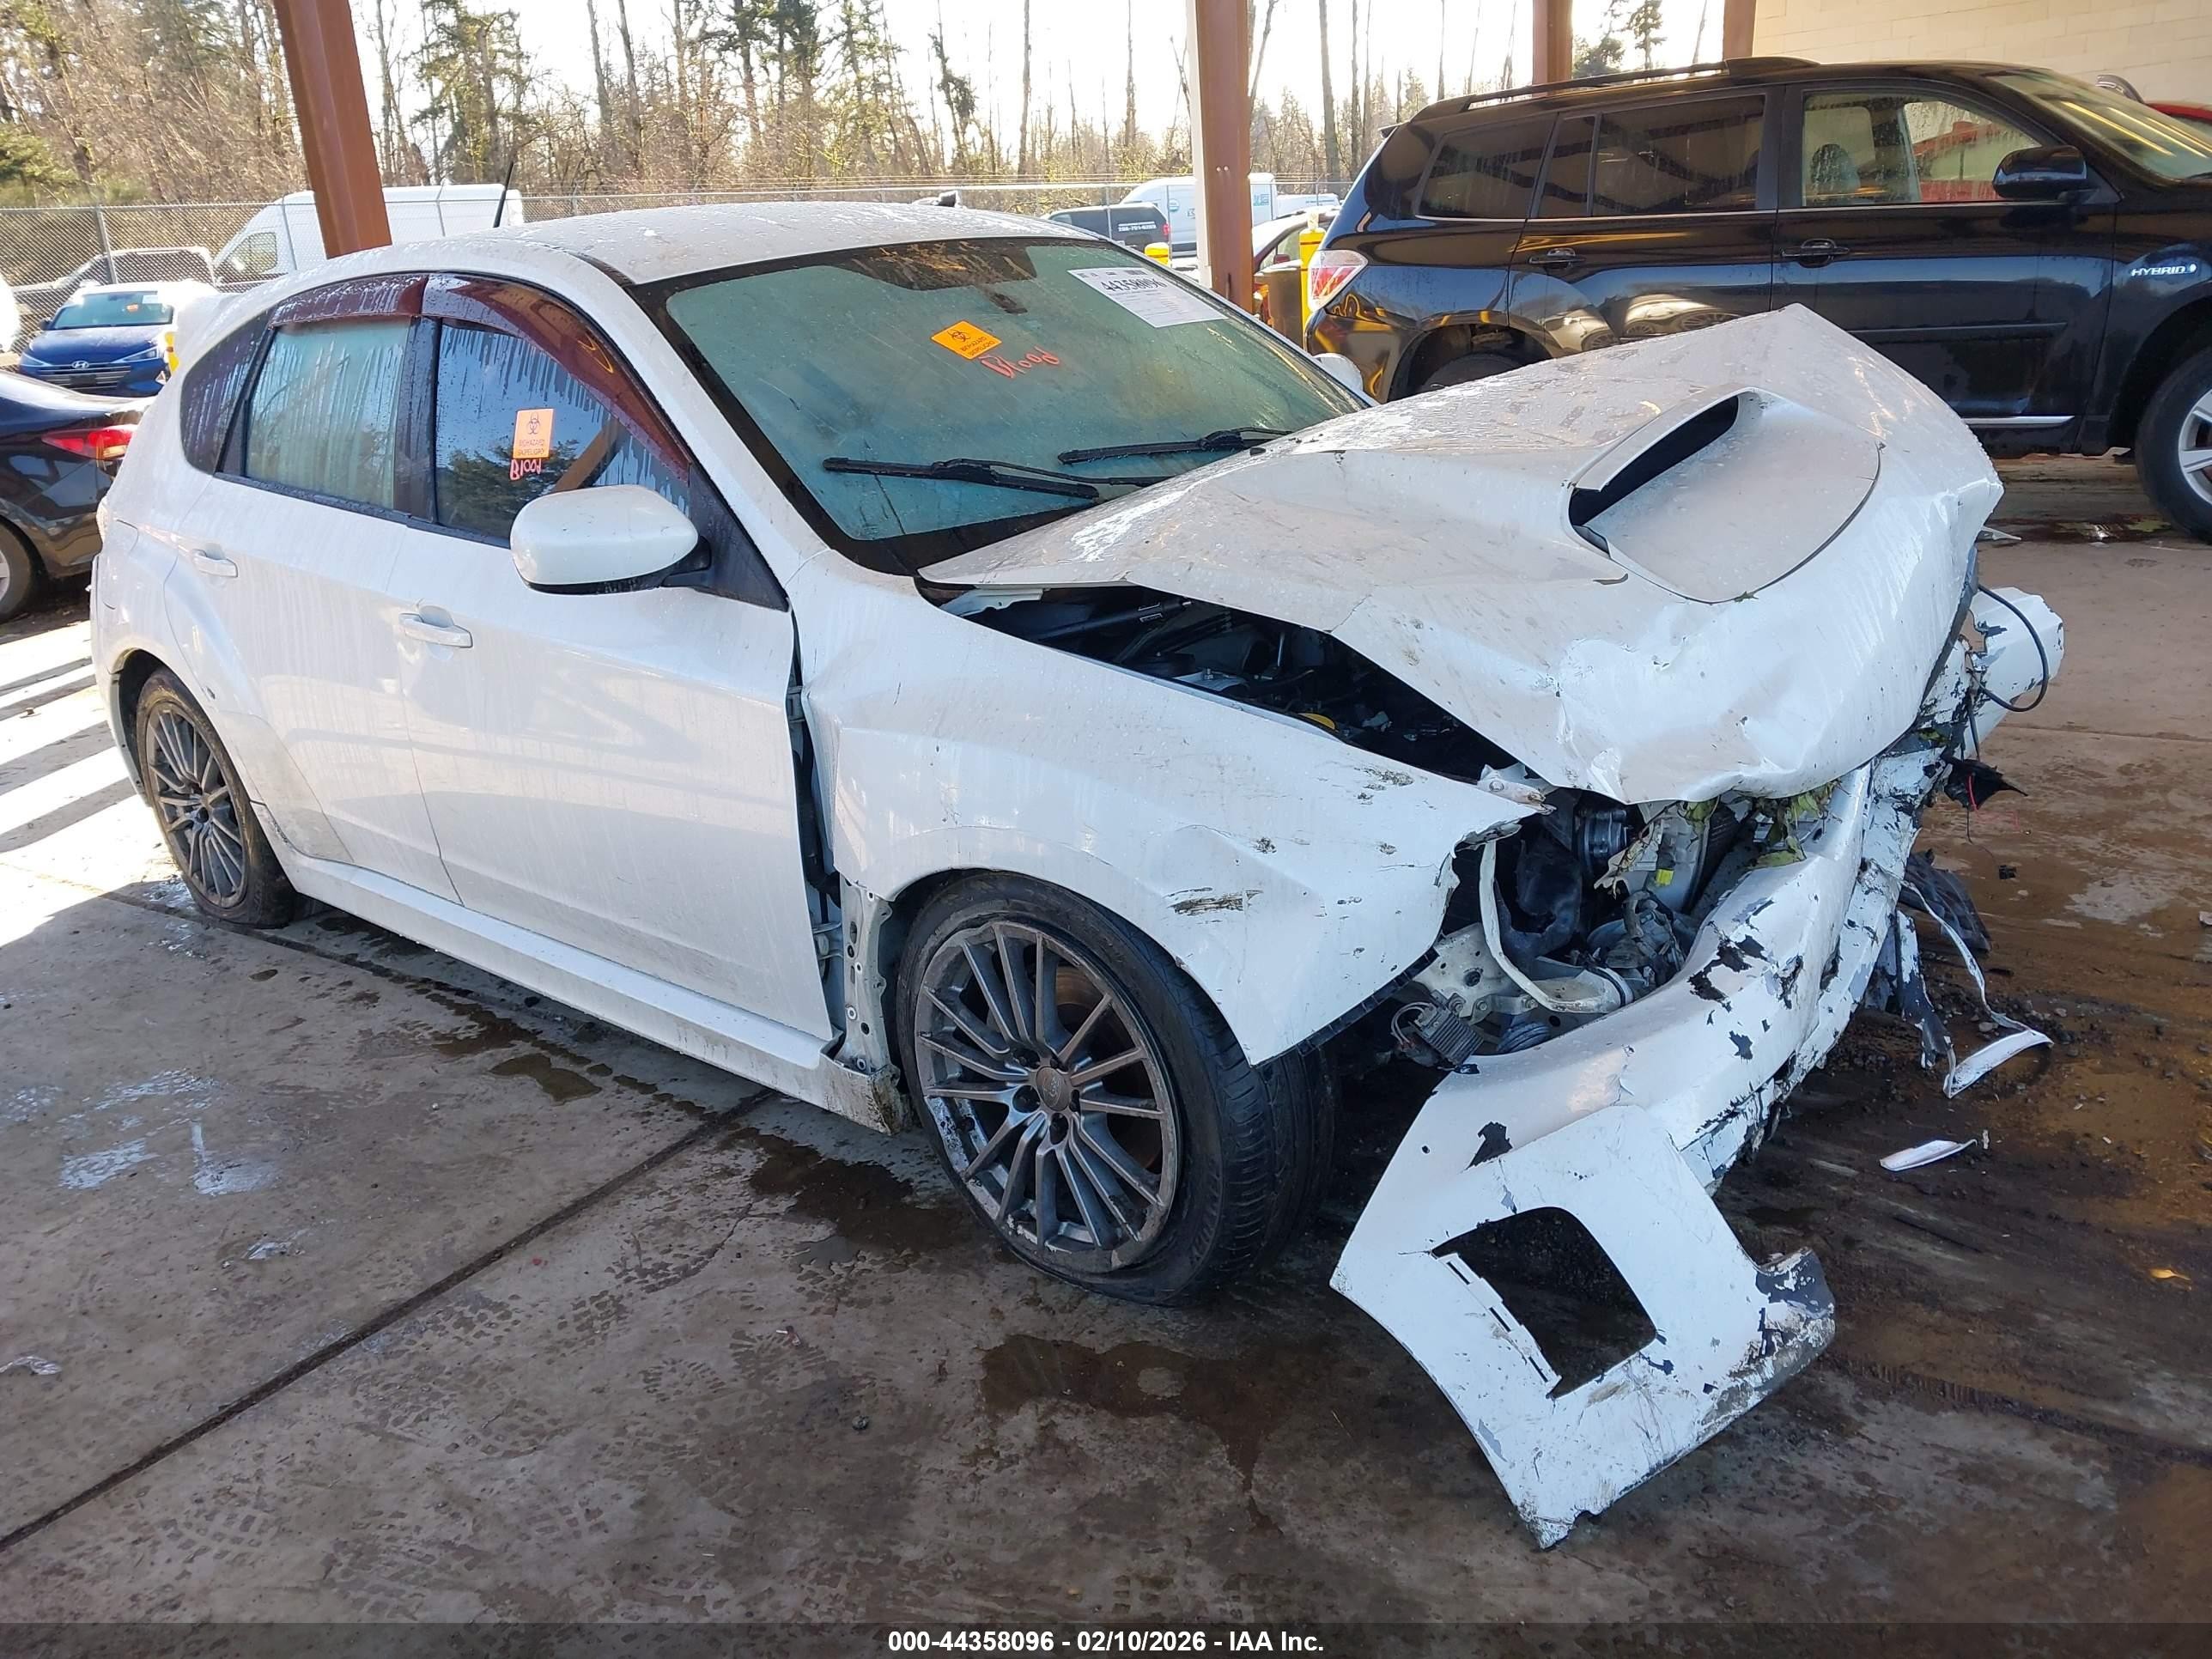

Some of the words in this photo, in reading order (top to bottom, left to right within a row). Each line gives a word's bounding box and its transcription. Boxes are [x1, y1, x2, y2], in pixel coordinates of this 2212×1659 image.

[2131, 265, 2186, 276] HYBRID
[1100, 277, 1168, 292] 44358096
[977, 345, 1060, 379] Blood
[509, 458, 542, 481] Blood
